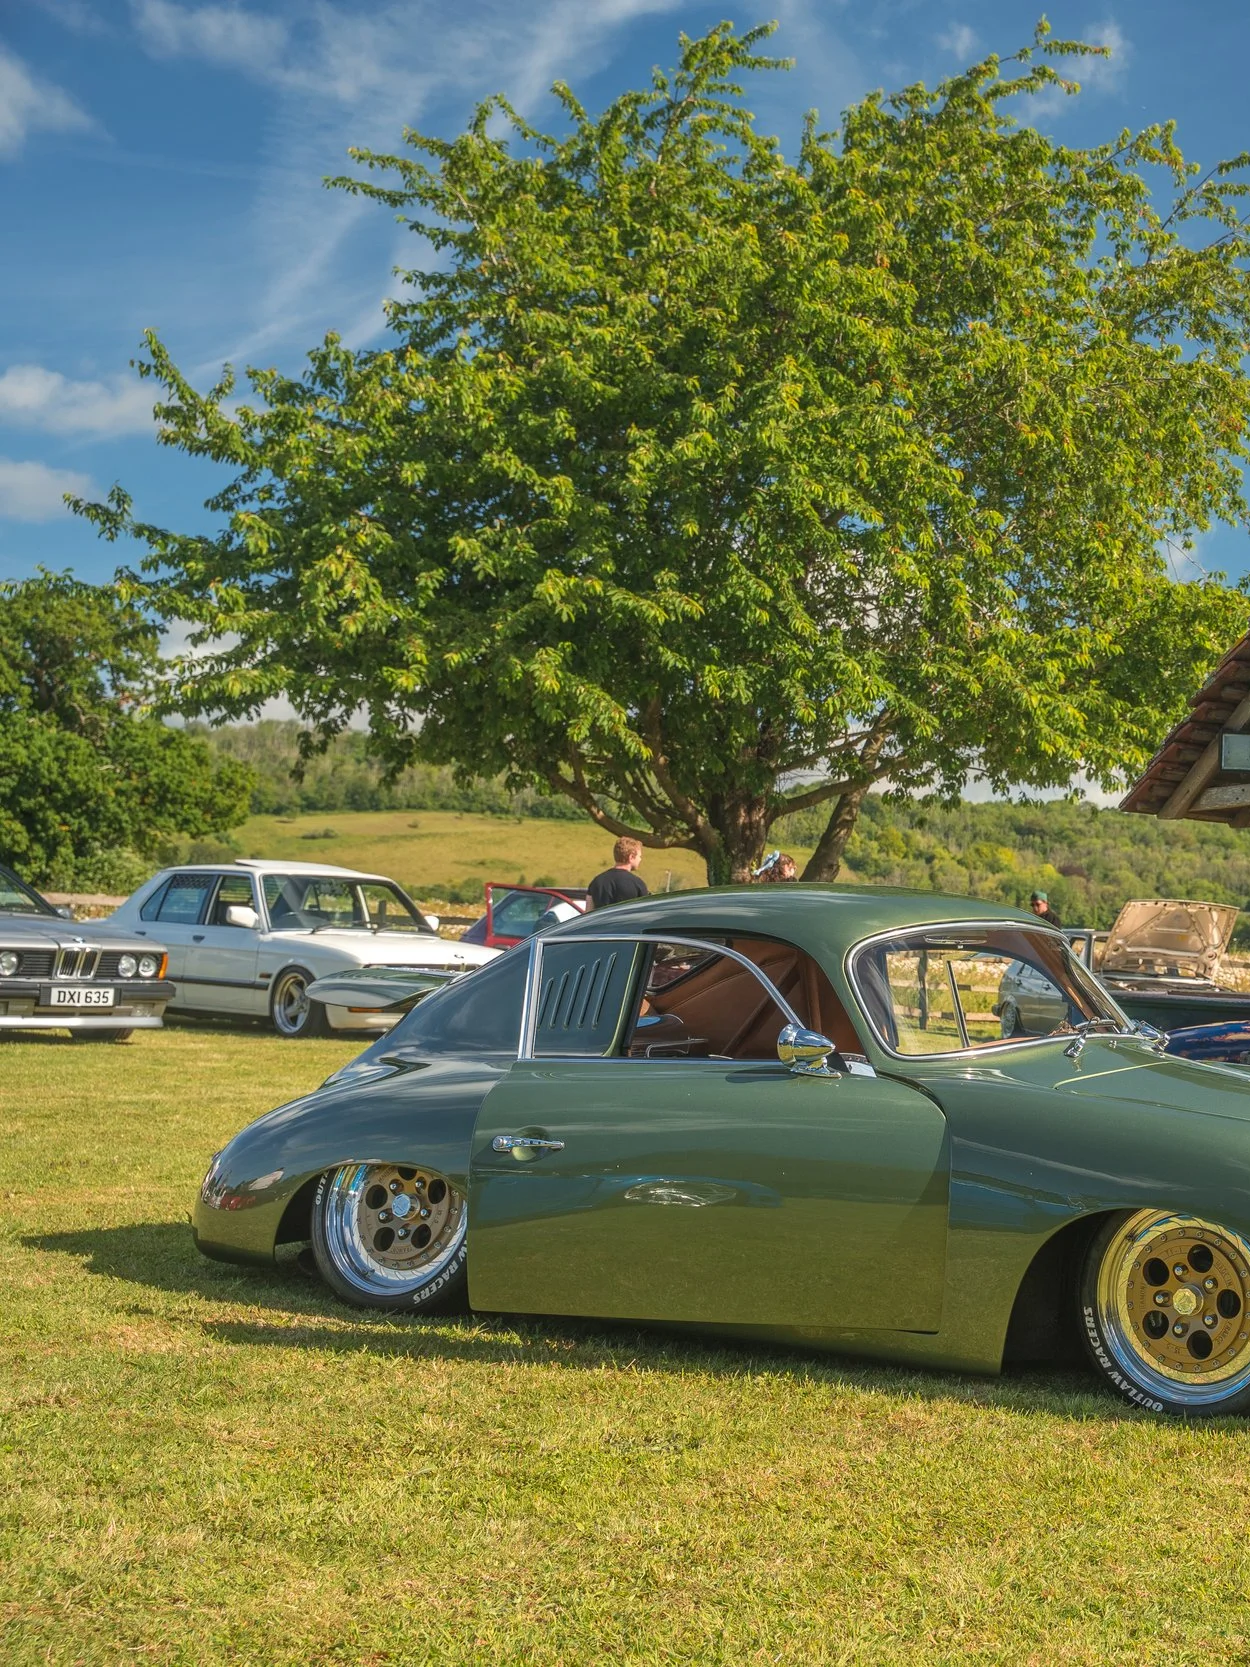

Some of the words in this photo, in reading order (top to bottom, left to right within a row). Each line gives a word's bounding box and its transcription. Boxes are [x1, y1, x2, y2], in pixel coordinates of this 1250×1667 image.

[57, 990, 81, 1003] DXI
[84, 990, 110, 1004] 635
[412, 1260, 459, 1305] RACERS
[1083, 1306, 1113, 1369] RACERS
[1107, 1371, 1164, 1412] OUTLAW
